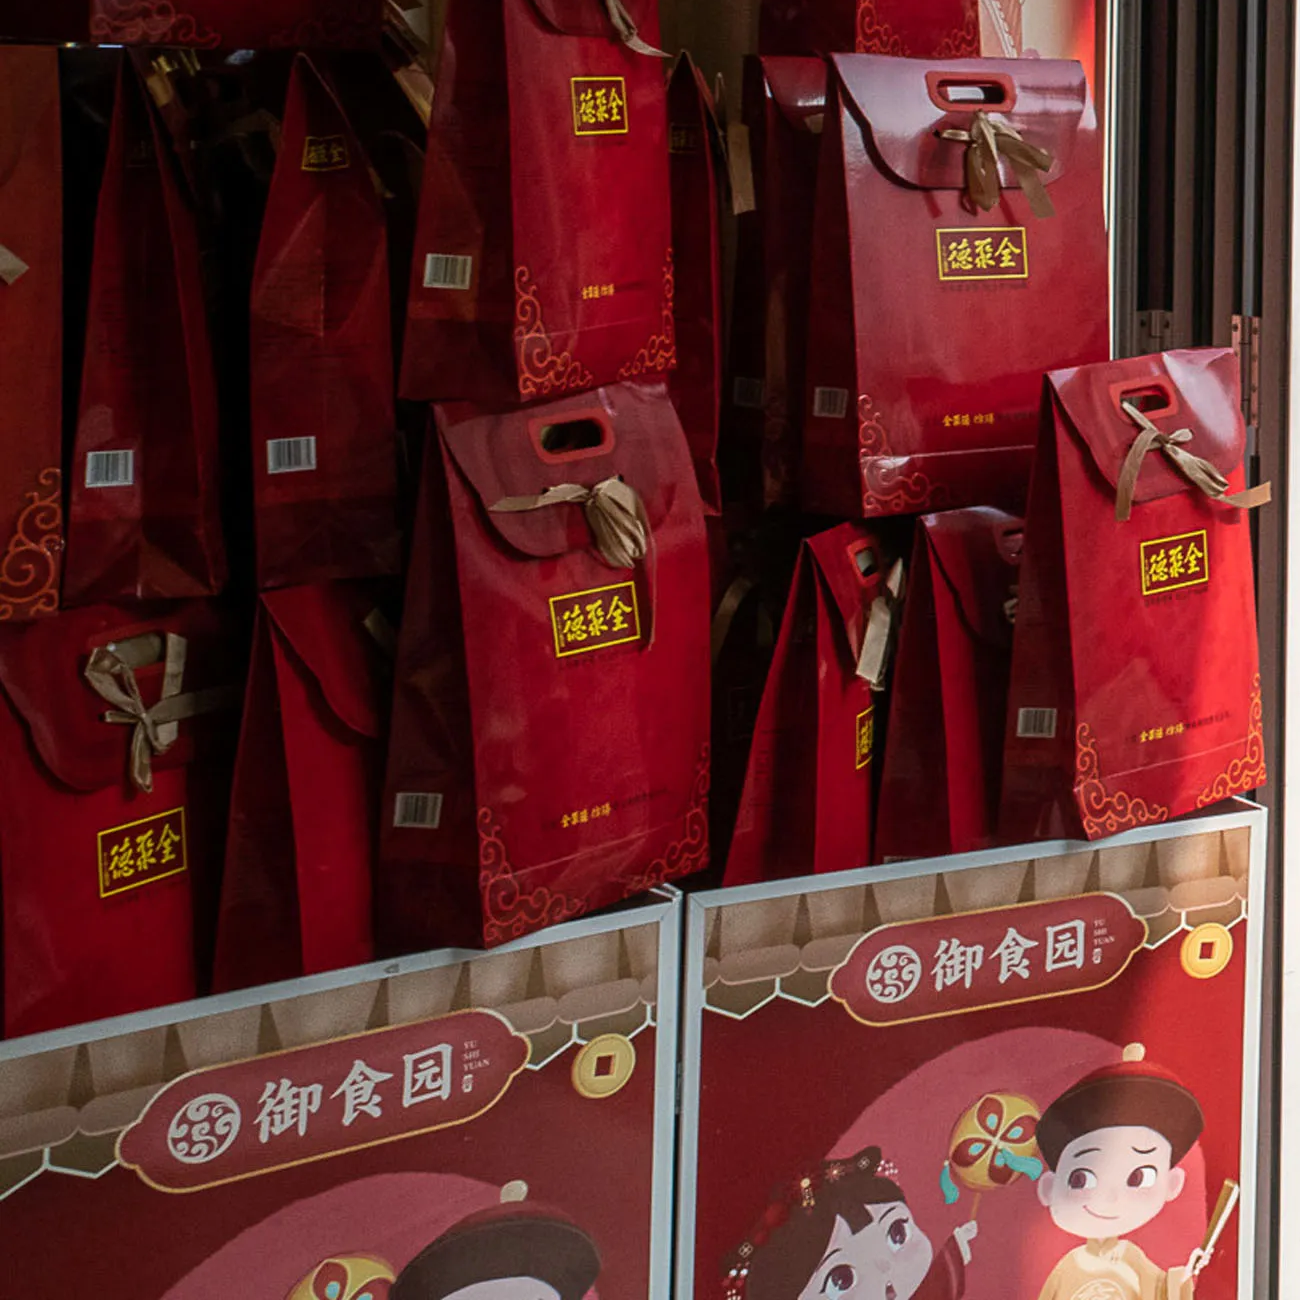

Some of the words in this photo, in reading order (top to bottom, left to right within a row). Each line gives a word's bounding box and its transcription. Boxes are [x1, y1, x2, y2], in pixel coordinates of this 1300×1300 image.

[930, 918, 1086, 992] 御食园
[253, 1042, 454, 1144] 御食园
